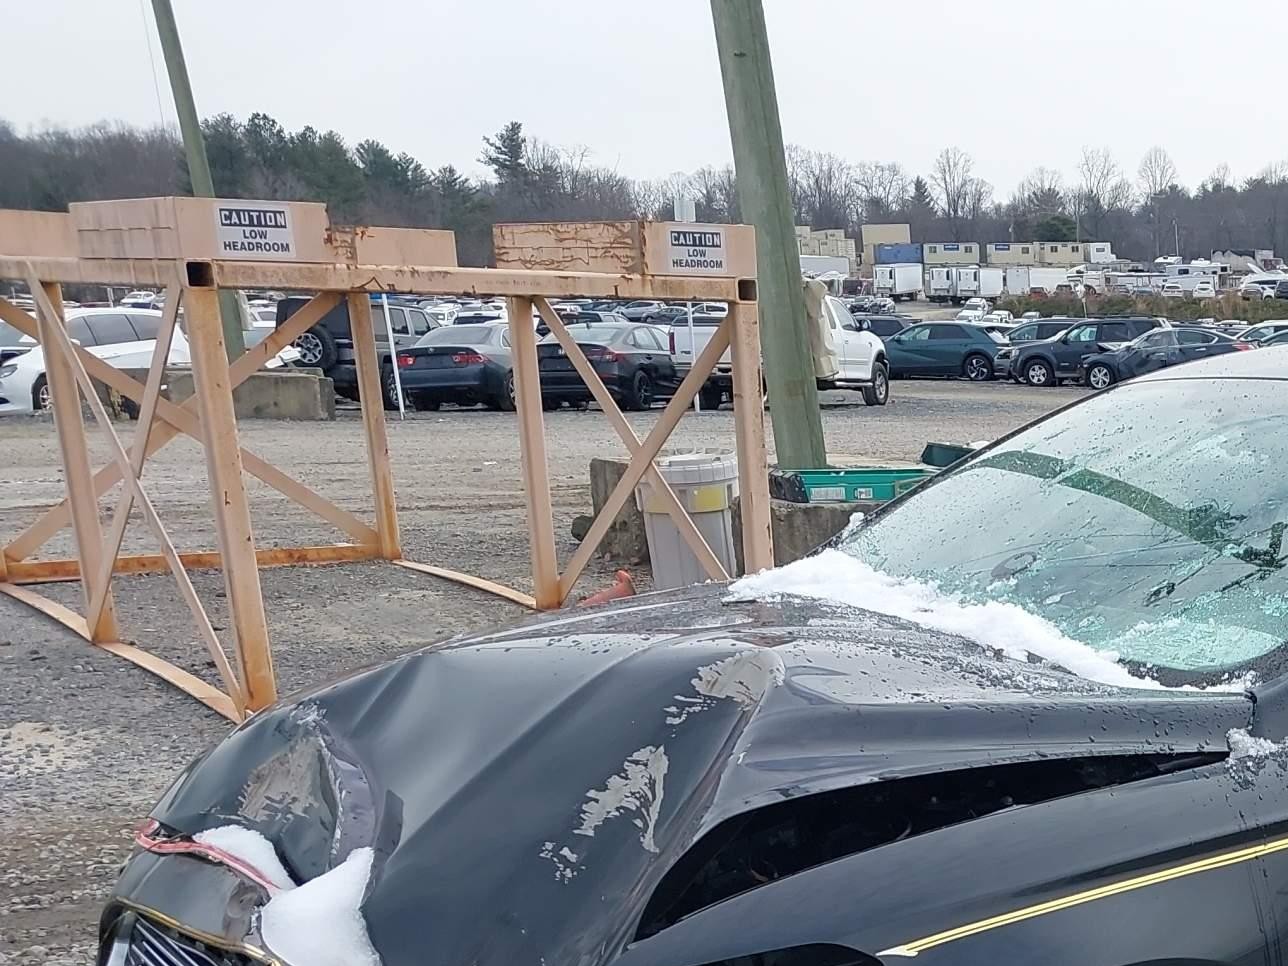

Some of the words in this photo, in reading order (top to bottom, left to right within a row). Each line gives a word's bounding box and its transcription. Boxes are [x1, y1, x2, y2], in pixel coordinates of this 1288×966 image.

[220, 210, 286, 226] CAUTION
[242, 229, 268, 240] LOW
[671, 232, 720, 246] CAUTION
[223, 241, 290, 253] HEADROOM
[687, 248, 707, 258] LOW
[672, 259, 723, 269] HEADROOM
